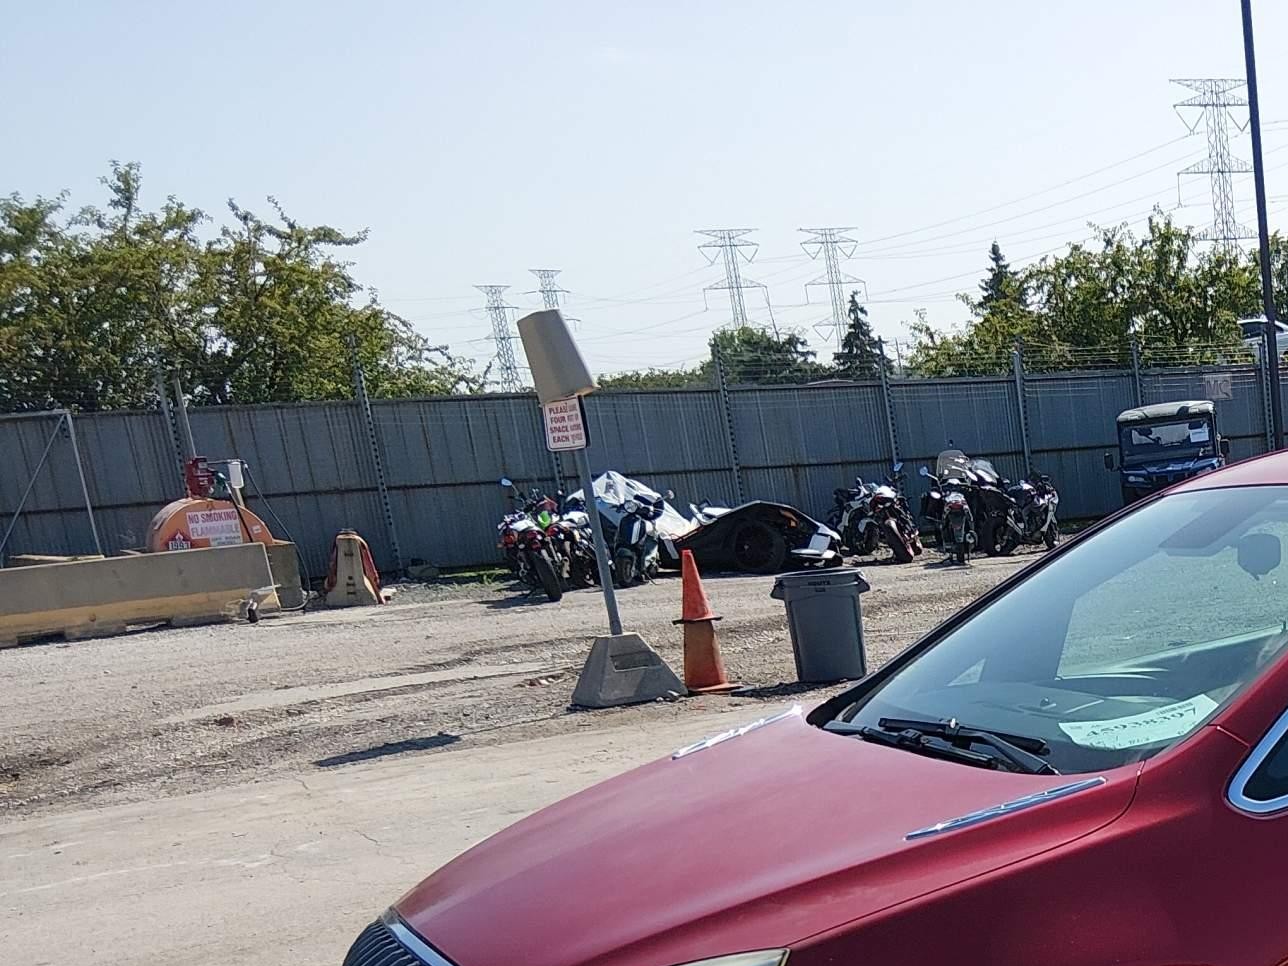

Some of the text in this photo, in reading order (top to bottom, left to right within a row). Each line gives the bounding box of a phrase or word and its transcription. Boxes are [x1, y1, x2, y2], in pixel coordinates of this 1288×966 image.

[551, 415, 567, 424] FOUR
[550, 425, 570, 433] SPACE
[553, 435, 570, 443] EACH
[188, 510, 238, 525] NO SMOKING
